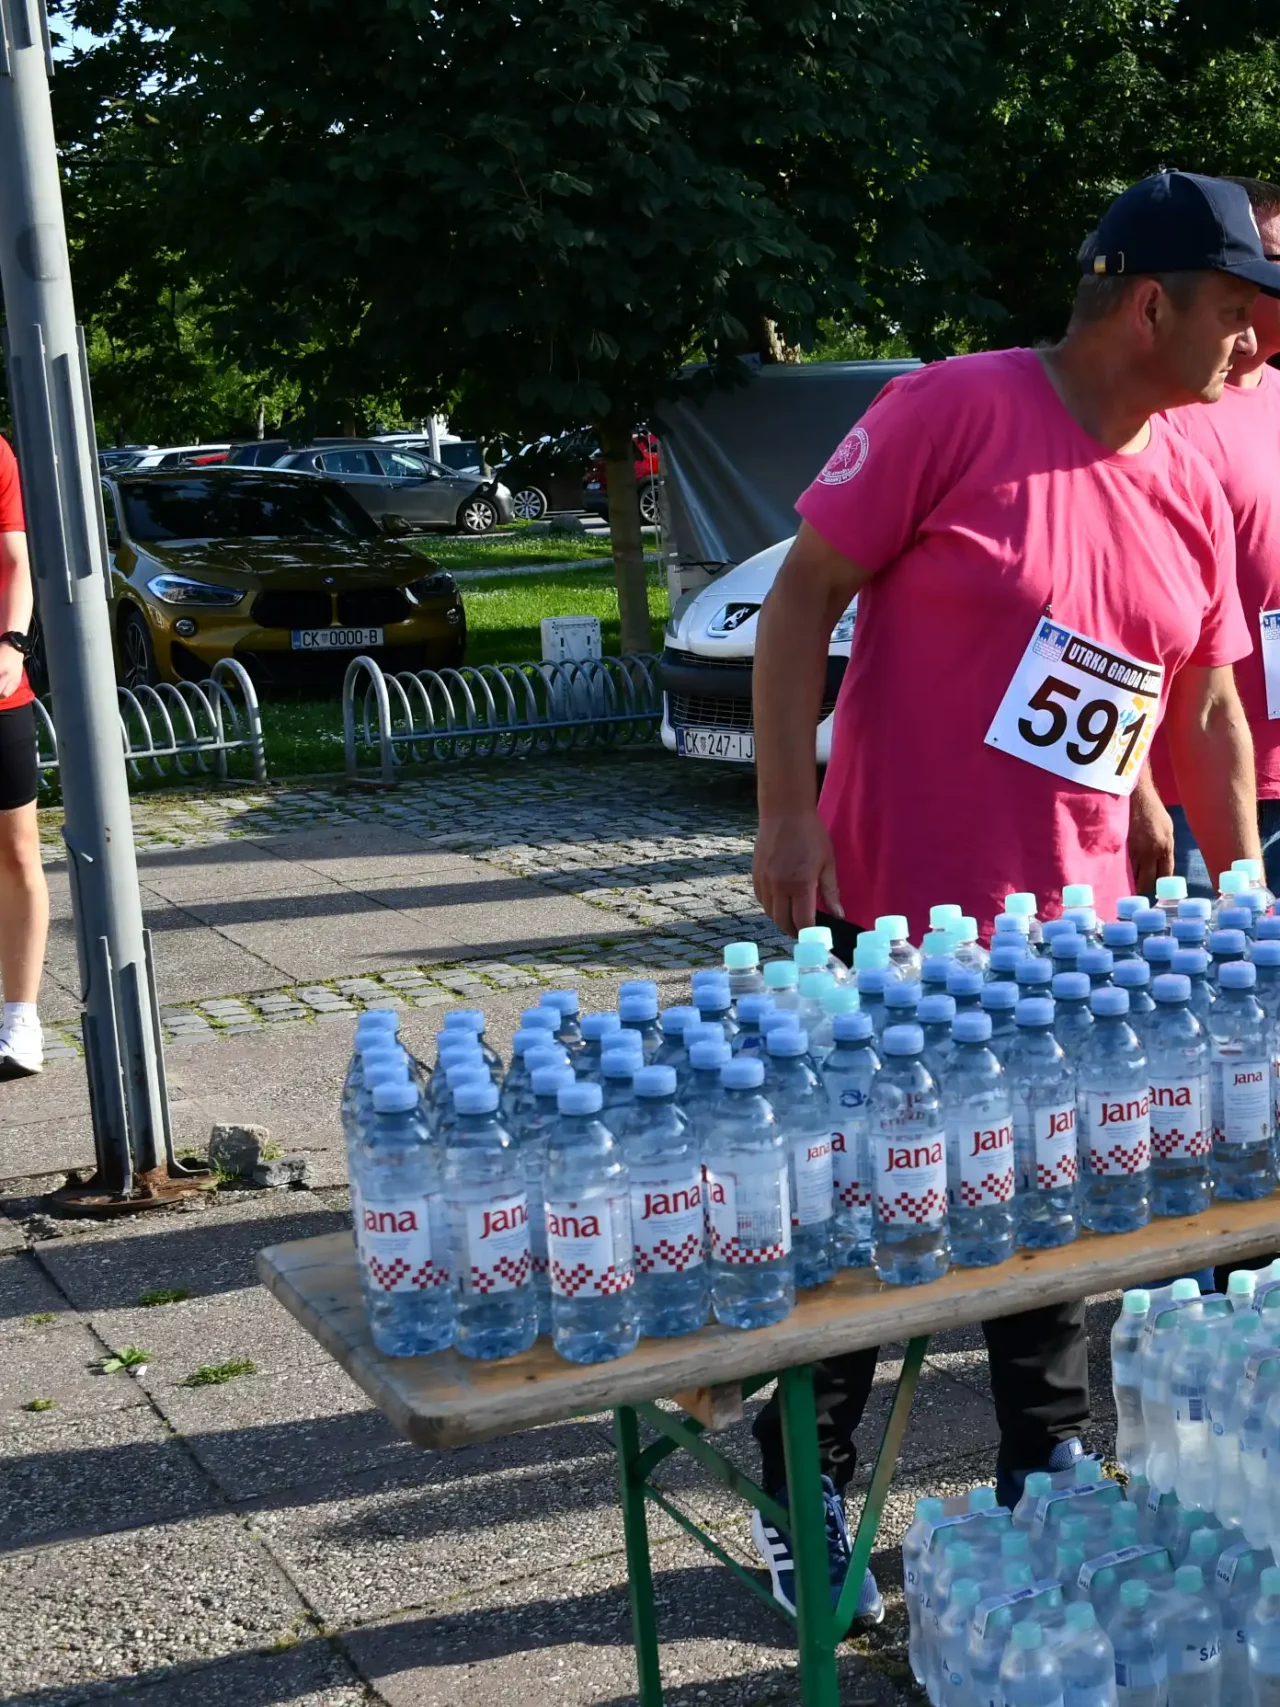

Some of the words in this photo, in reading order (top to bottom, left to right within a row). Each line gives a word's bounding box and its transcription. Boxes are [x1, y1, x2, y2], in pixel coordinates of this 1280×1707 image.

[302, 632, 320, 646] CK
[1068, 643, 1107, 673] UTRKA
[1107, 662, 1142, 688] GRADA
[1018, 675, 1147, 776] 591
[685, 731, 699, 753] CK
[1233, 1071, 1263, 1086] Jana
[1098, 1095, 1149, 1127] Jana
[885, 1141, 943, 1172] Jana
[641, 1184, 702, 1220] Jana
